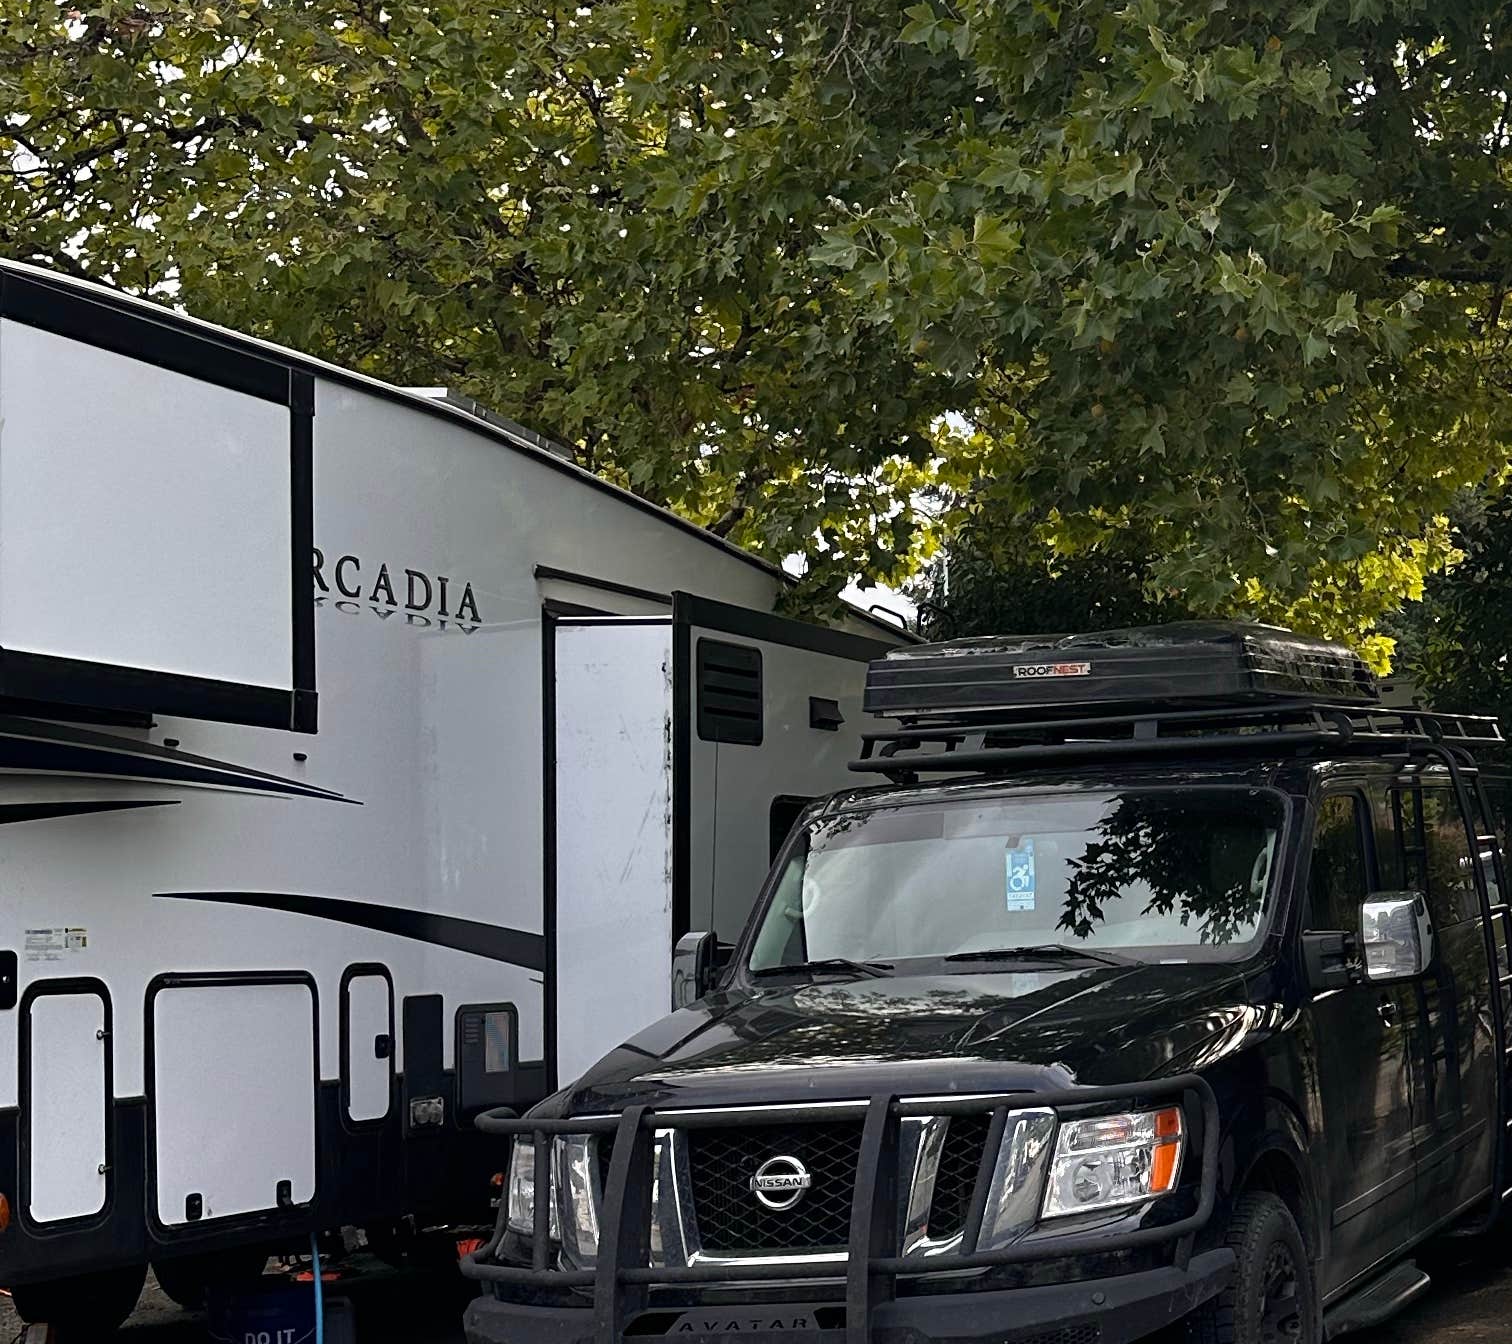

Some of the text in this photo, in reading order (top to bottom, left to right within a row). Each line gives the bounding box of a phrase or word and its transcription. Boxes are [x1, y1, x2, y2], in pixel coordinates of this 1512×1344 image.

[313, 547, 482, 623] RCADIA
[1018, 664, 1086, 676] ROOFNEST
[755, 1177, 803, 1188] NISSAN
[679, 1318, 807, 1332] AVATAR
[277, 1328, 296, 1344] IT
